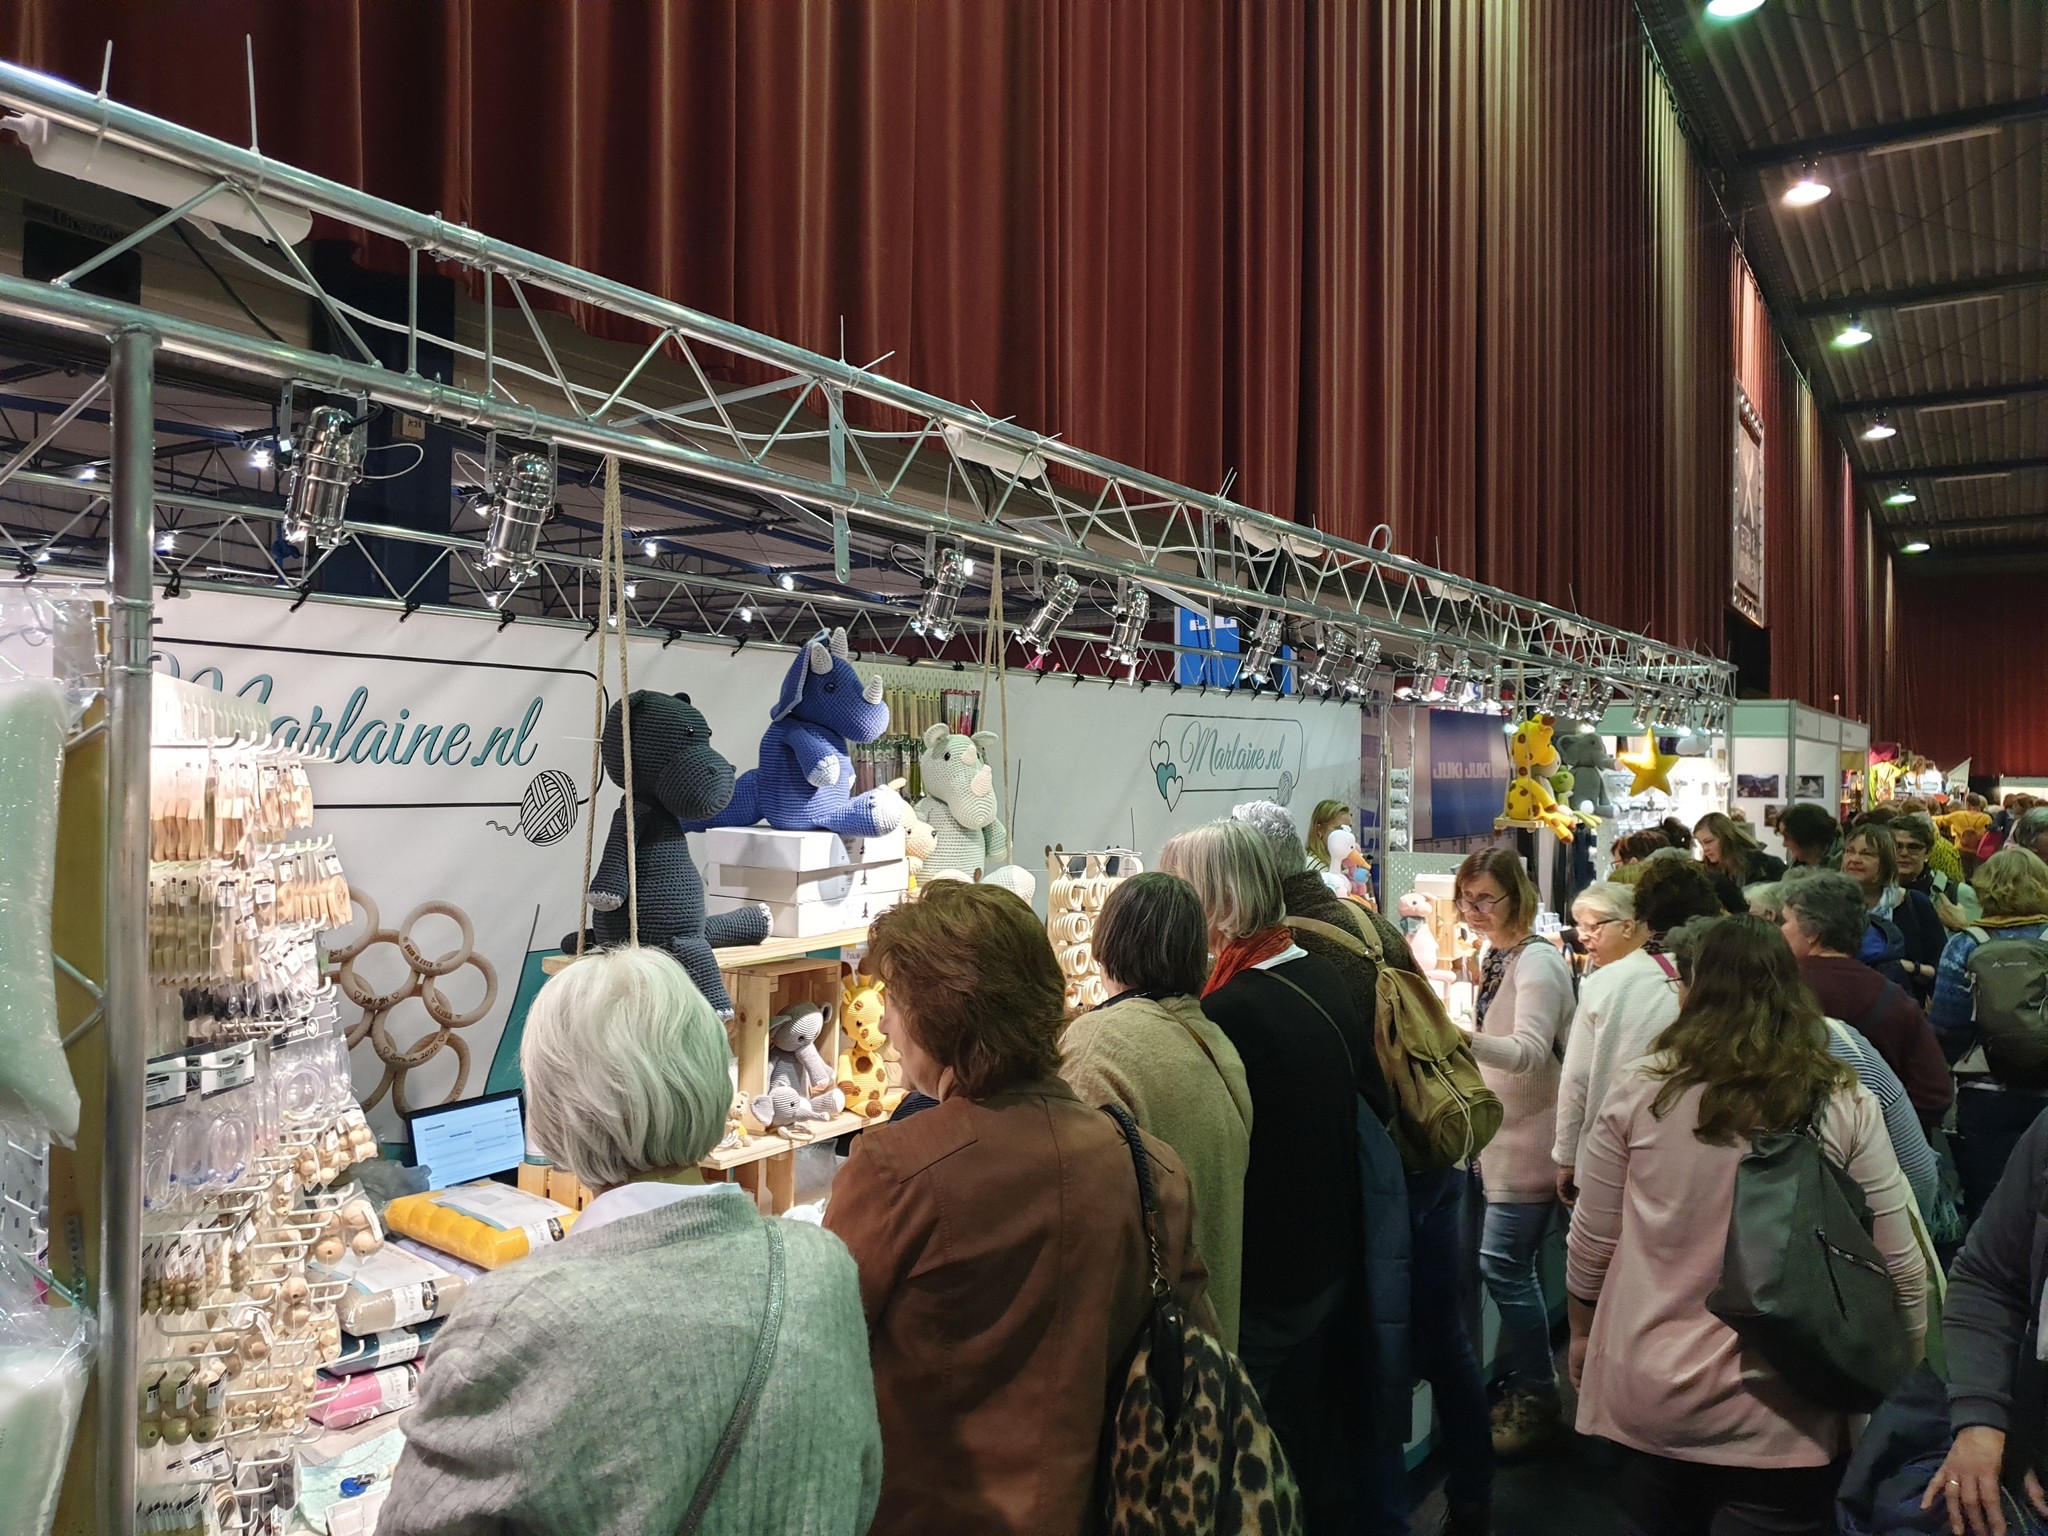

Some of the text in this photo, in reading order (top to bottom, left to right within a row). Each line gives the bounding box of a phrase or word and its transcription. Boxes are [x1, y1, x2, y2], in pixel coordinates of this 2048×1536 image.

[1179, 720, 1286, 777] Marlaine.nl
[1432, 761, 1463, 779] JUKI
[1464, 761, 1491, 779] JUKI
[420, 1043, 438, 1060] 2020
